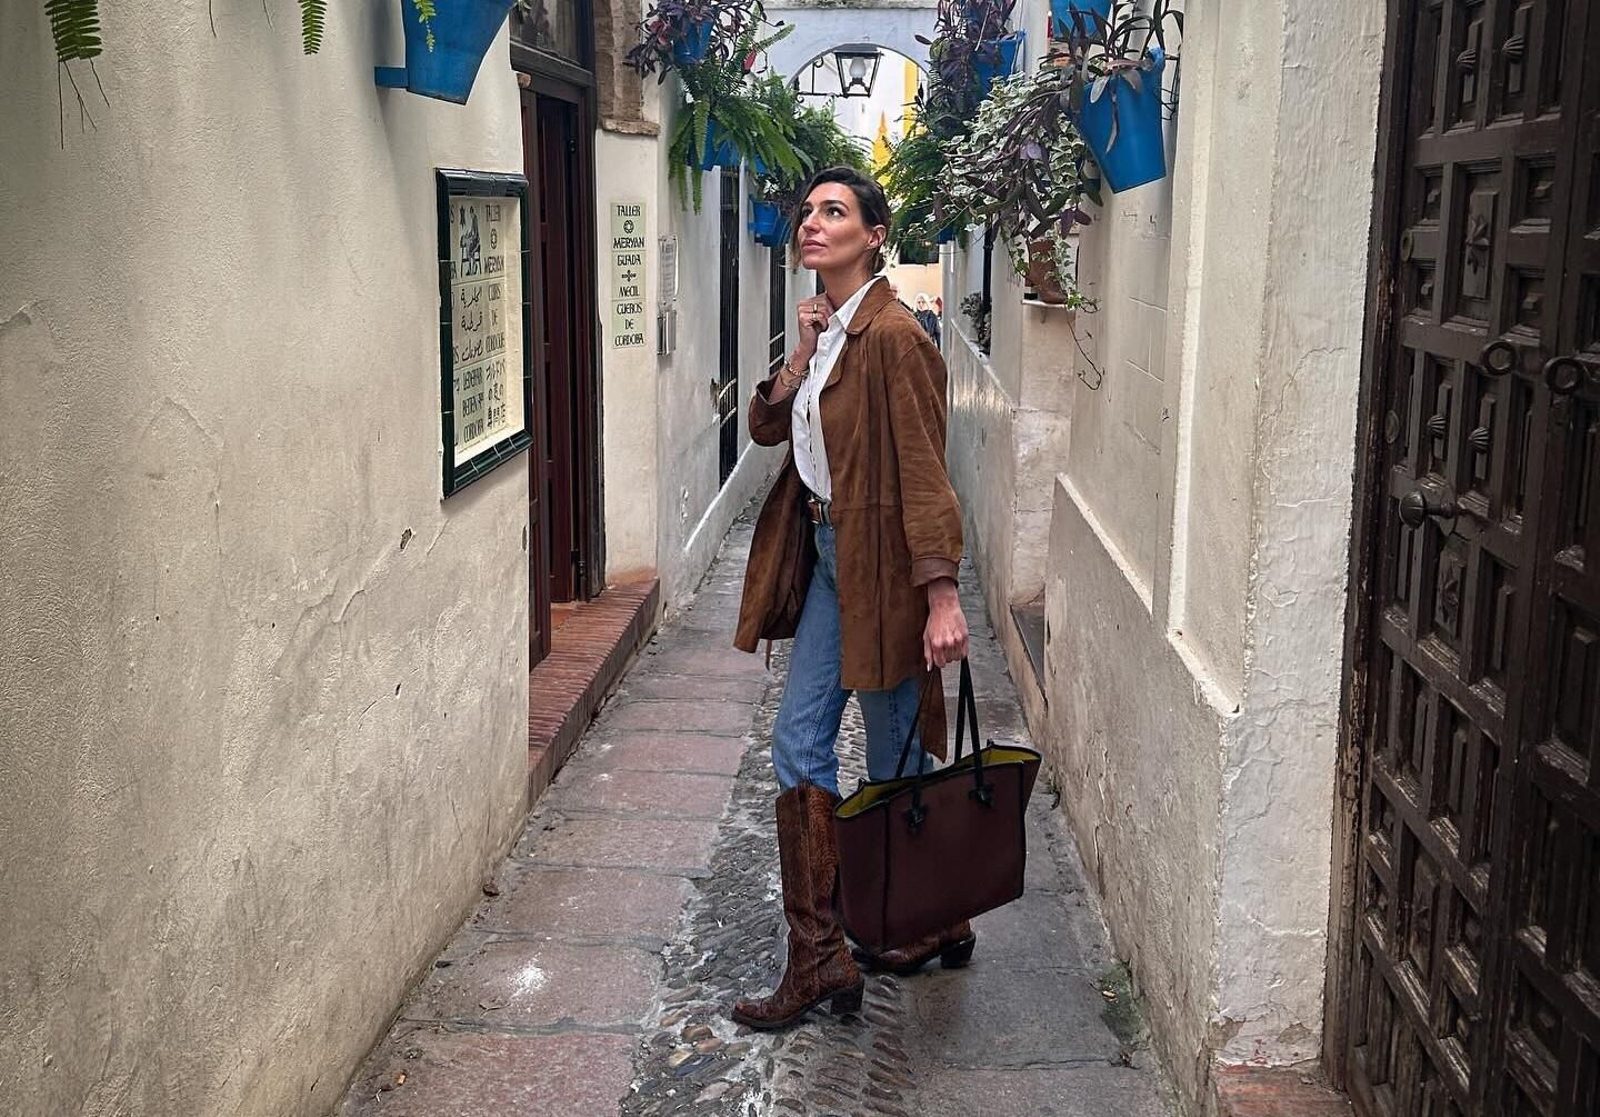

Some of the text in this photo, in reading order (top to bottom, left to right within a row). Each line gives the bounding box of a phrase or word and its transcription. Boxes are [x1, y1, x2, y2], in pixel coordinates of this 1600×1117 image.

[616, 204, 641, 217] TALLER
[612, 236, 645, 249] MERYAN
[617, 254, 642, 266] GUADA
[616, 302, 643, 315] CUEROS
[624, 319, 634, 330] DE
[614, 333, 644, 347] CORDOBA
